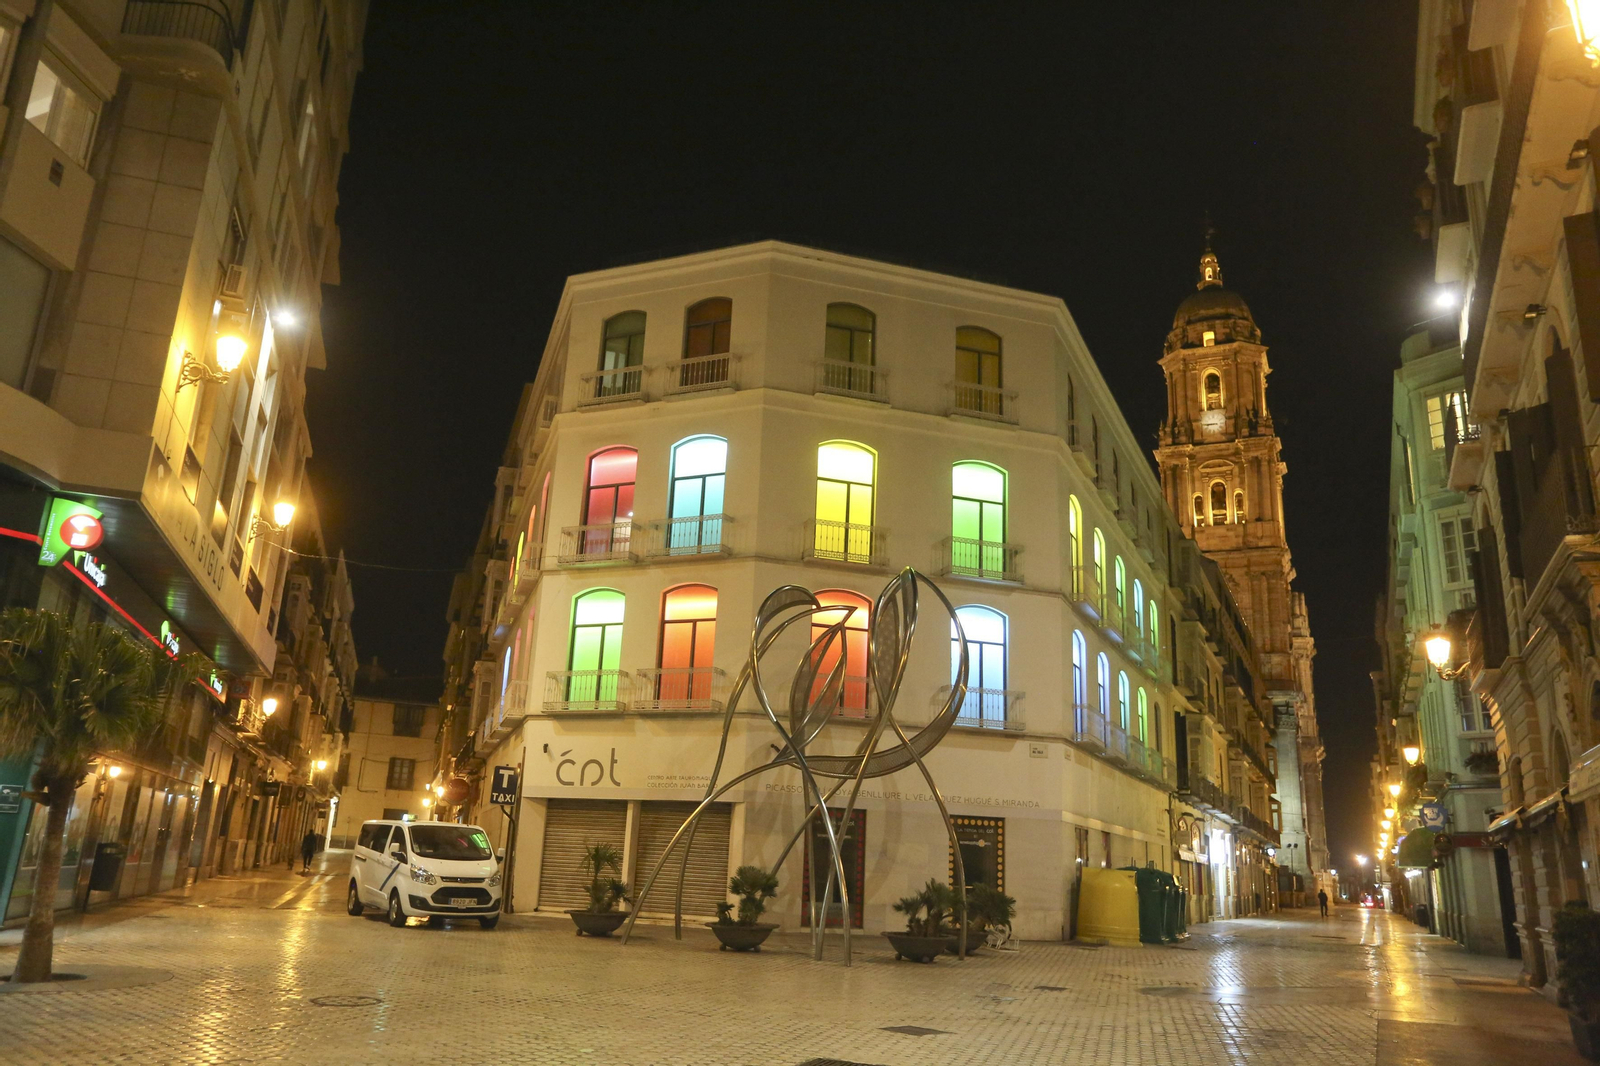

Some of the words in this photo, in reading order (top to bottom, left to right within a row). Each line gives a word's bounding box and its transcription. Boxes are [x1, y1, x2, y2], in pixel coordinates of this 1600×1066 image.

[198, 534, 225, 591] SIGLO
[499, 769, 514, 788] T
[492, 792, 515, 803] TAXI
[765, 783, 803, 794] PICASSO
[913, 793, 962, 804] VELAQUEZ
[1002, 799, 1040, 808] MIRANDA
